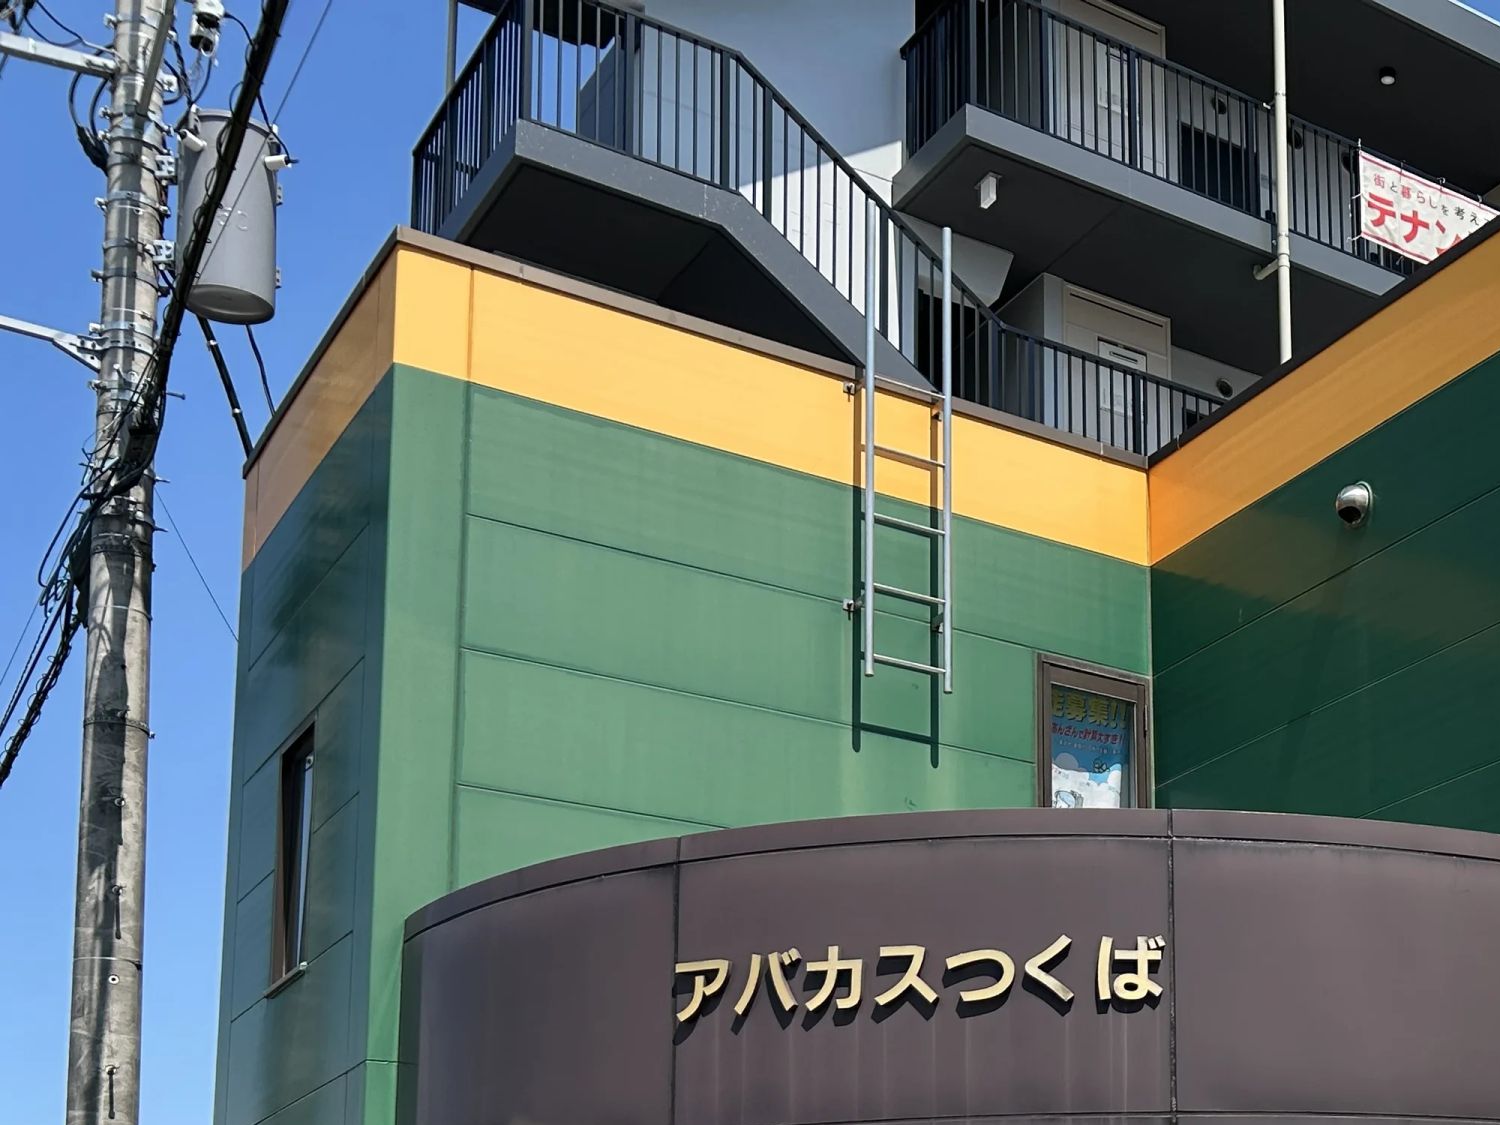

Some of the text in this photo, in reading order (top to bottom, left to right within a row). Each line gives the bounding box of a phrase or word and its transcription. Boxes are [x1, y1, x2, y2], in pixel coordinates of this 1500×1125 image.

[1374, 174, 1492, 226] 街と暮らしを考え
[675, 934, 1167, 1022] アバカスつくば
